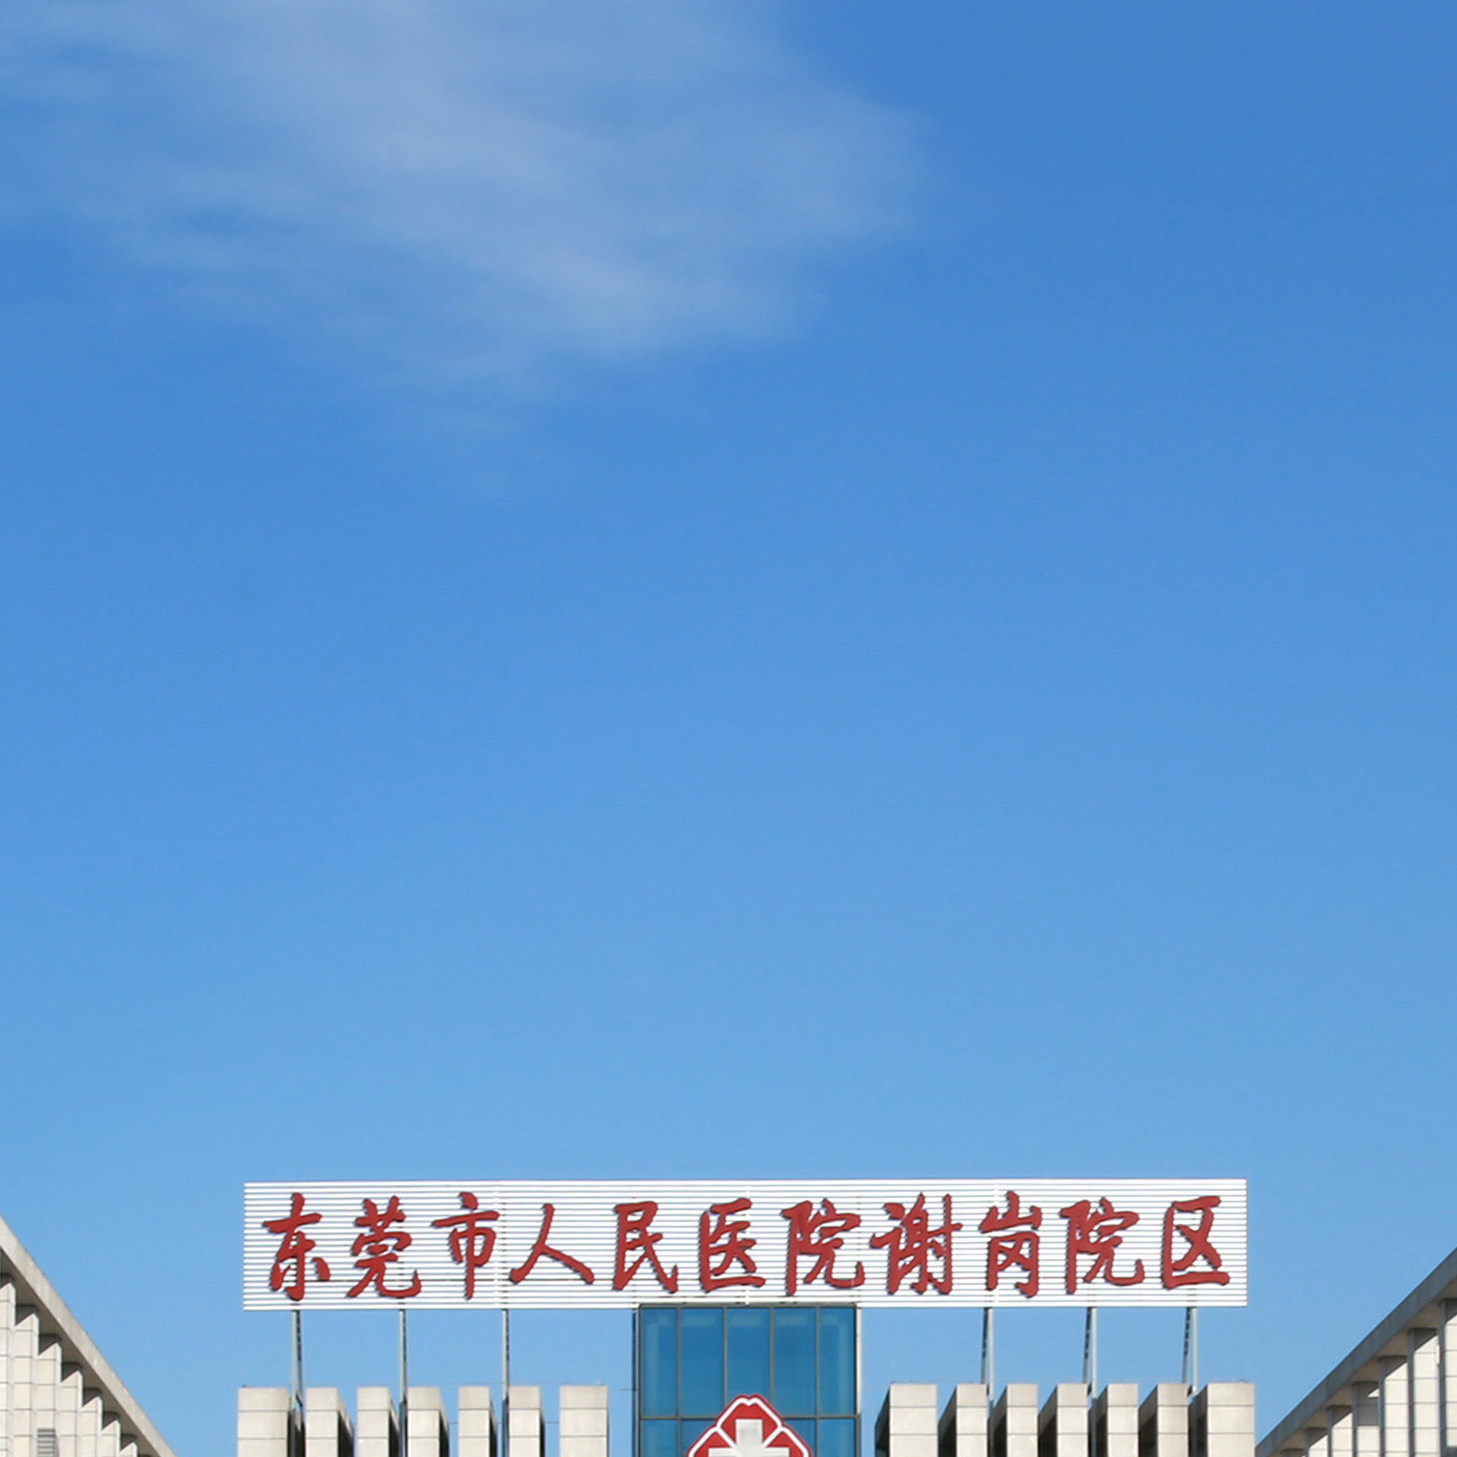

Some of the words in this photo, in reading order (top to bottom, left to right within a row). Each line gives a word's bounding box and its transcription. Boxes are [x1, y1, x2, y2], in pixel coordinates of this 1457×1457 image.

[262, 1191, 1231, 1302] 东莞市人民医院谢岗院区
